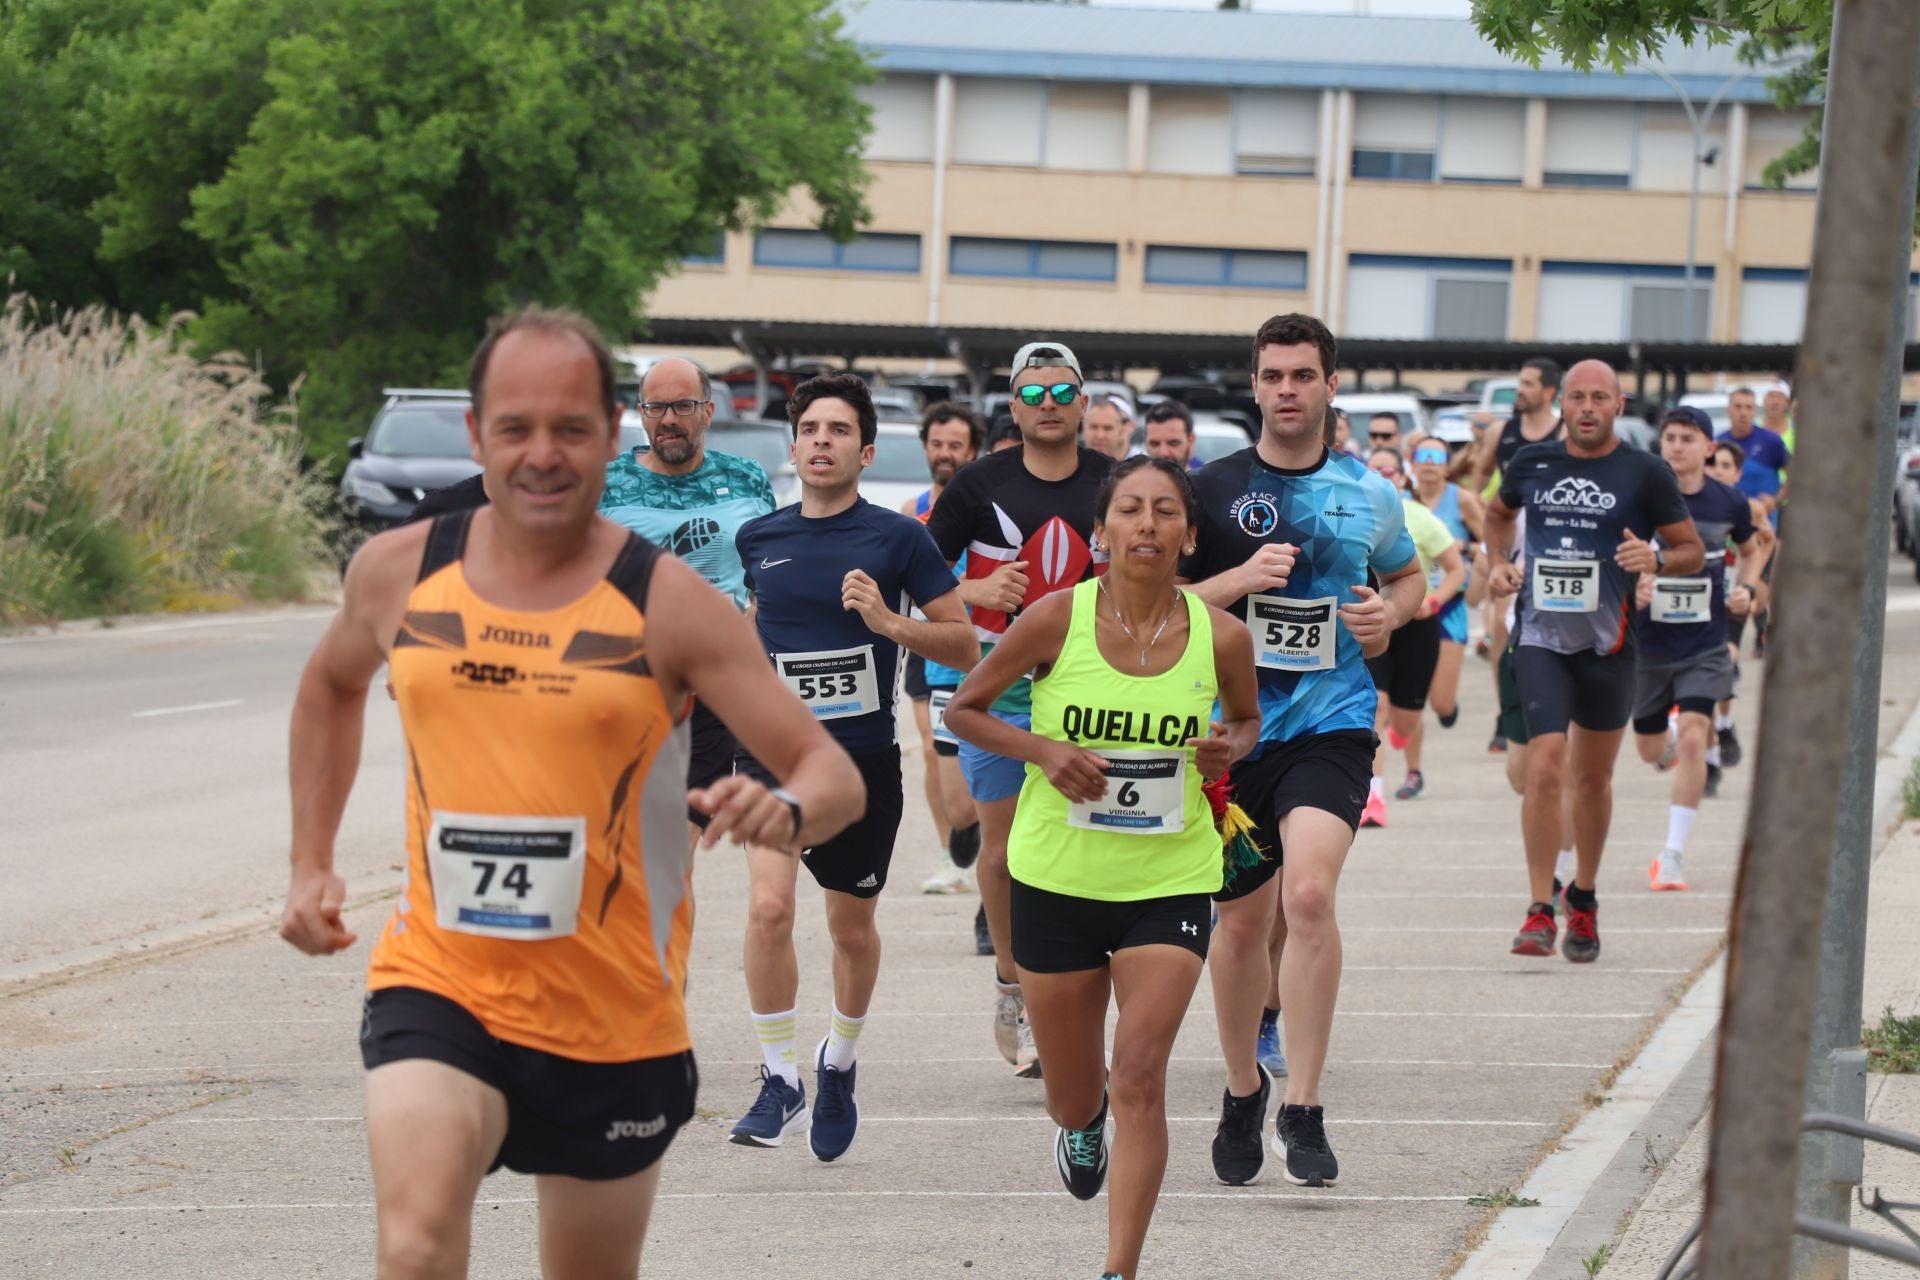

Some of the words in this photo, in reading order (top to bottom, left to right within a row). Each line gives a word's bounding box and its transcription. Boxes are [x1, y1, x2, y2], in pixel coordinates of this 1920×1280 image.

[1229, 493, 1250, 519] IBERUS
[1251, 491, 1278, 504] RACE
[1544, 578, 1583, 595] 518
[1670, 595, 1692, 609] 31
[1265, 622, 1321, 649] 528
[1277, 648, 1310, 656] ALBERTO
[799, 673, 858, 700] 553
[1063, 705, 1198, 747] QUELLCA
[1115, 762, 1139, 770] CIUDAD
[1117, 781, 1140, 808] 6
[1108, 808, 1147, 817] VIRGINIA
[1112, 817, 1150, 826] KILOMETROS
[472, 861, 533, 899] 74
